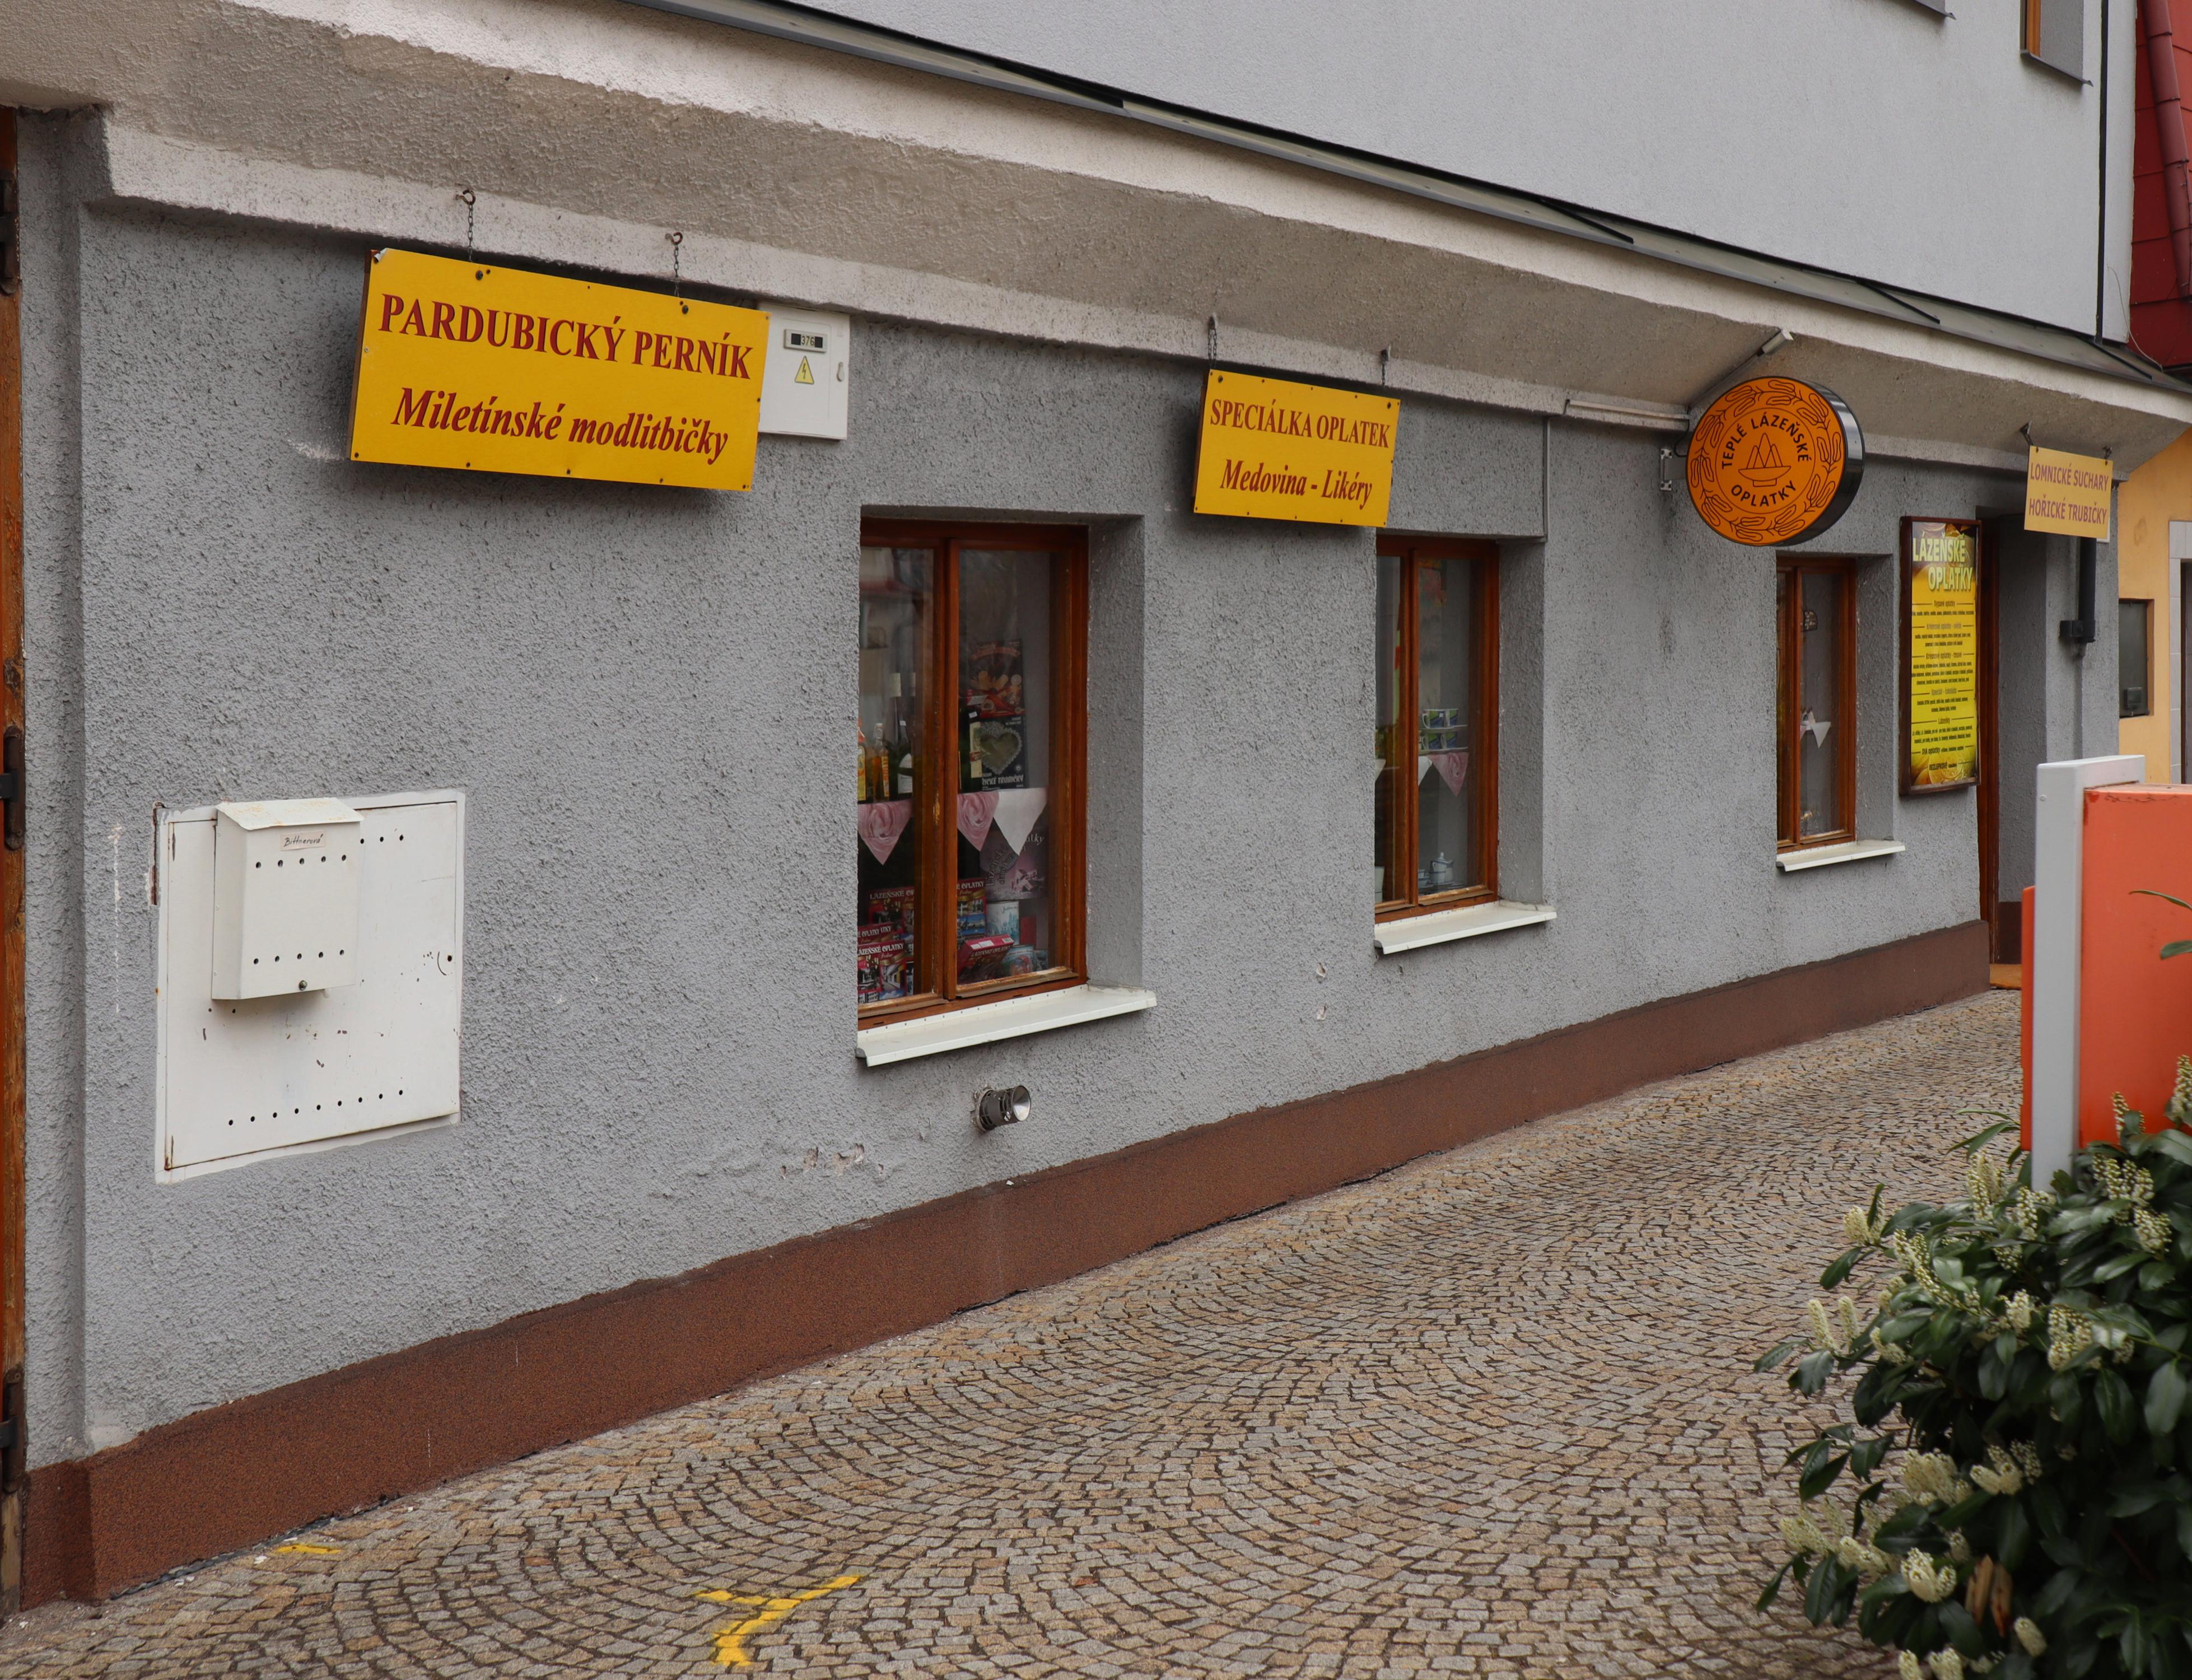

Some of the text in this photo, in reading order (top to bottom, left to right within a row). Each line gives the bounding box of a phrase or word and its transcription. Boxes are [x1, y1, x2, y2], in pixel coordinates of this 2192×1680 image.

[378, 294, 753, 380] PARDUBICKÝ PERNÍK
[801, 335, 815, 346] 376
[390, 388, 727, 465] Miletínské modlitbičky
[1210, 399, 1391, 448] SPECIÁLKA OPLATEK
[1721, 411, 1812, 470] TEPLÉ LÁZEŇSKÉ
[1220, 459, 1308, 497] Medovina
[1321, 469, 1372, 510] Likéry
[2030, 461, 2109, 492] LOMNICKÉ SUCHARY
[1731, 480, 1797, 507] OPLATKY
[2028, 494, 2107, 525] HOŘICKÉ TRUBIČKY
[1912, 531, 1966, 563] LÁZEŇSKÉ
[1928, 566, 1973, 591] OPLATKY
[962, 881, 985, 890] OPLATKY
[882, 943, 904, 953] OPLATKY
